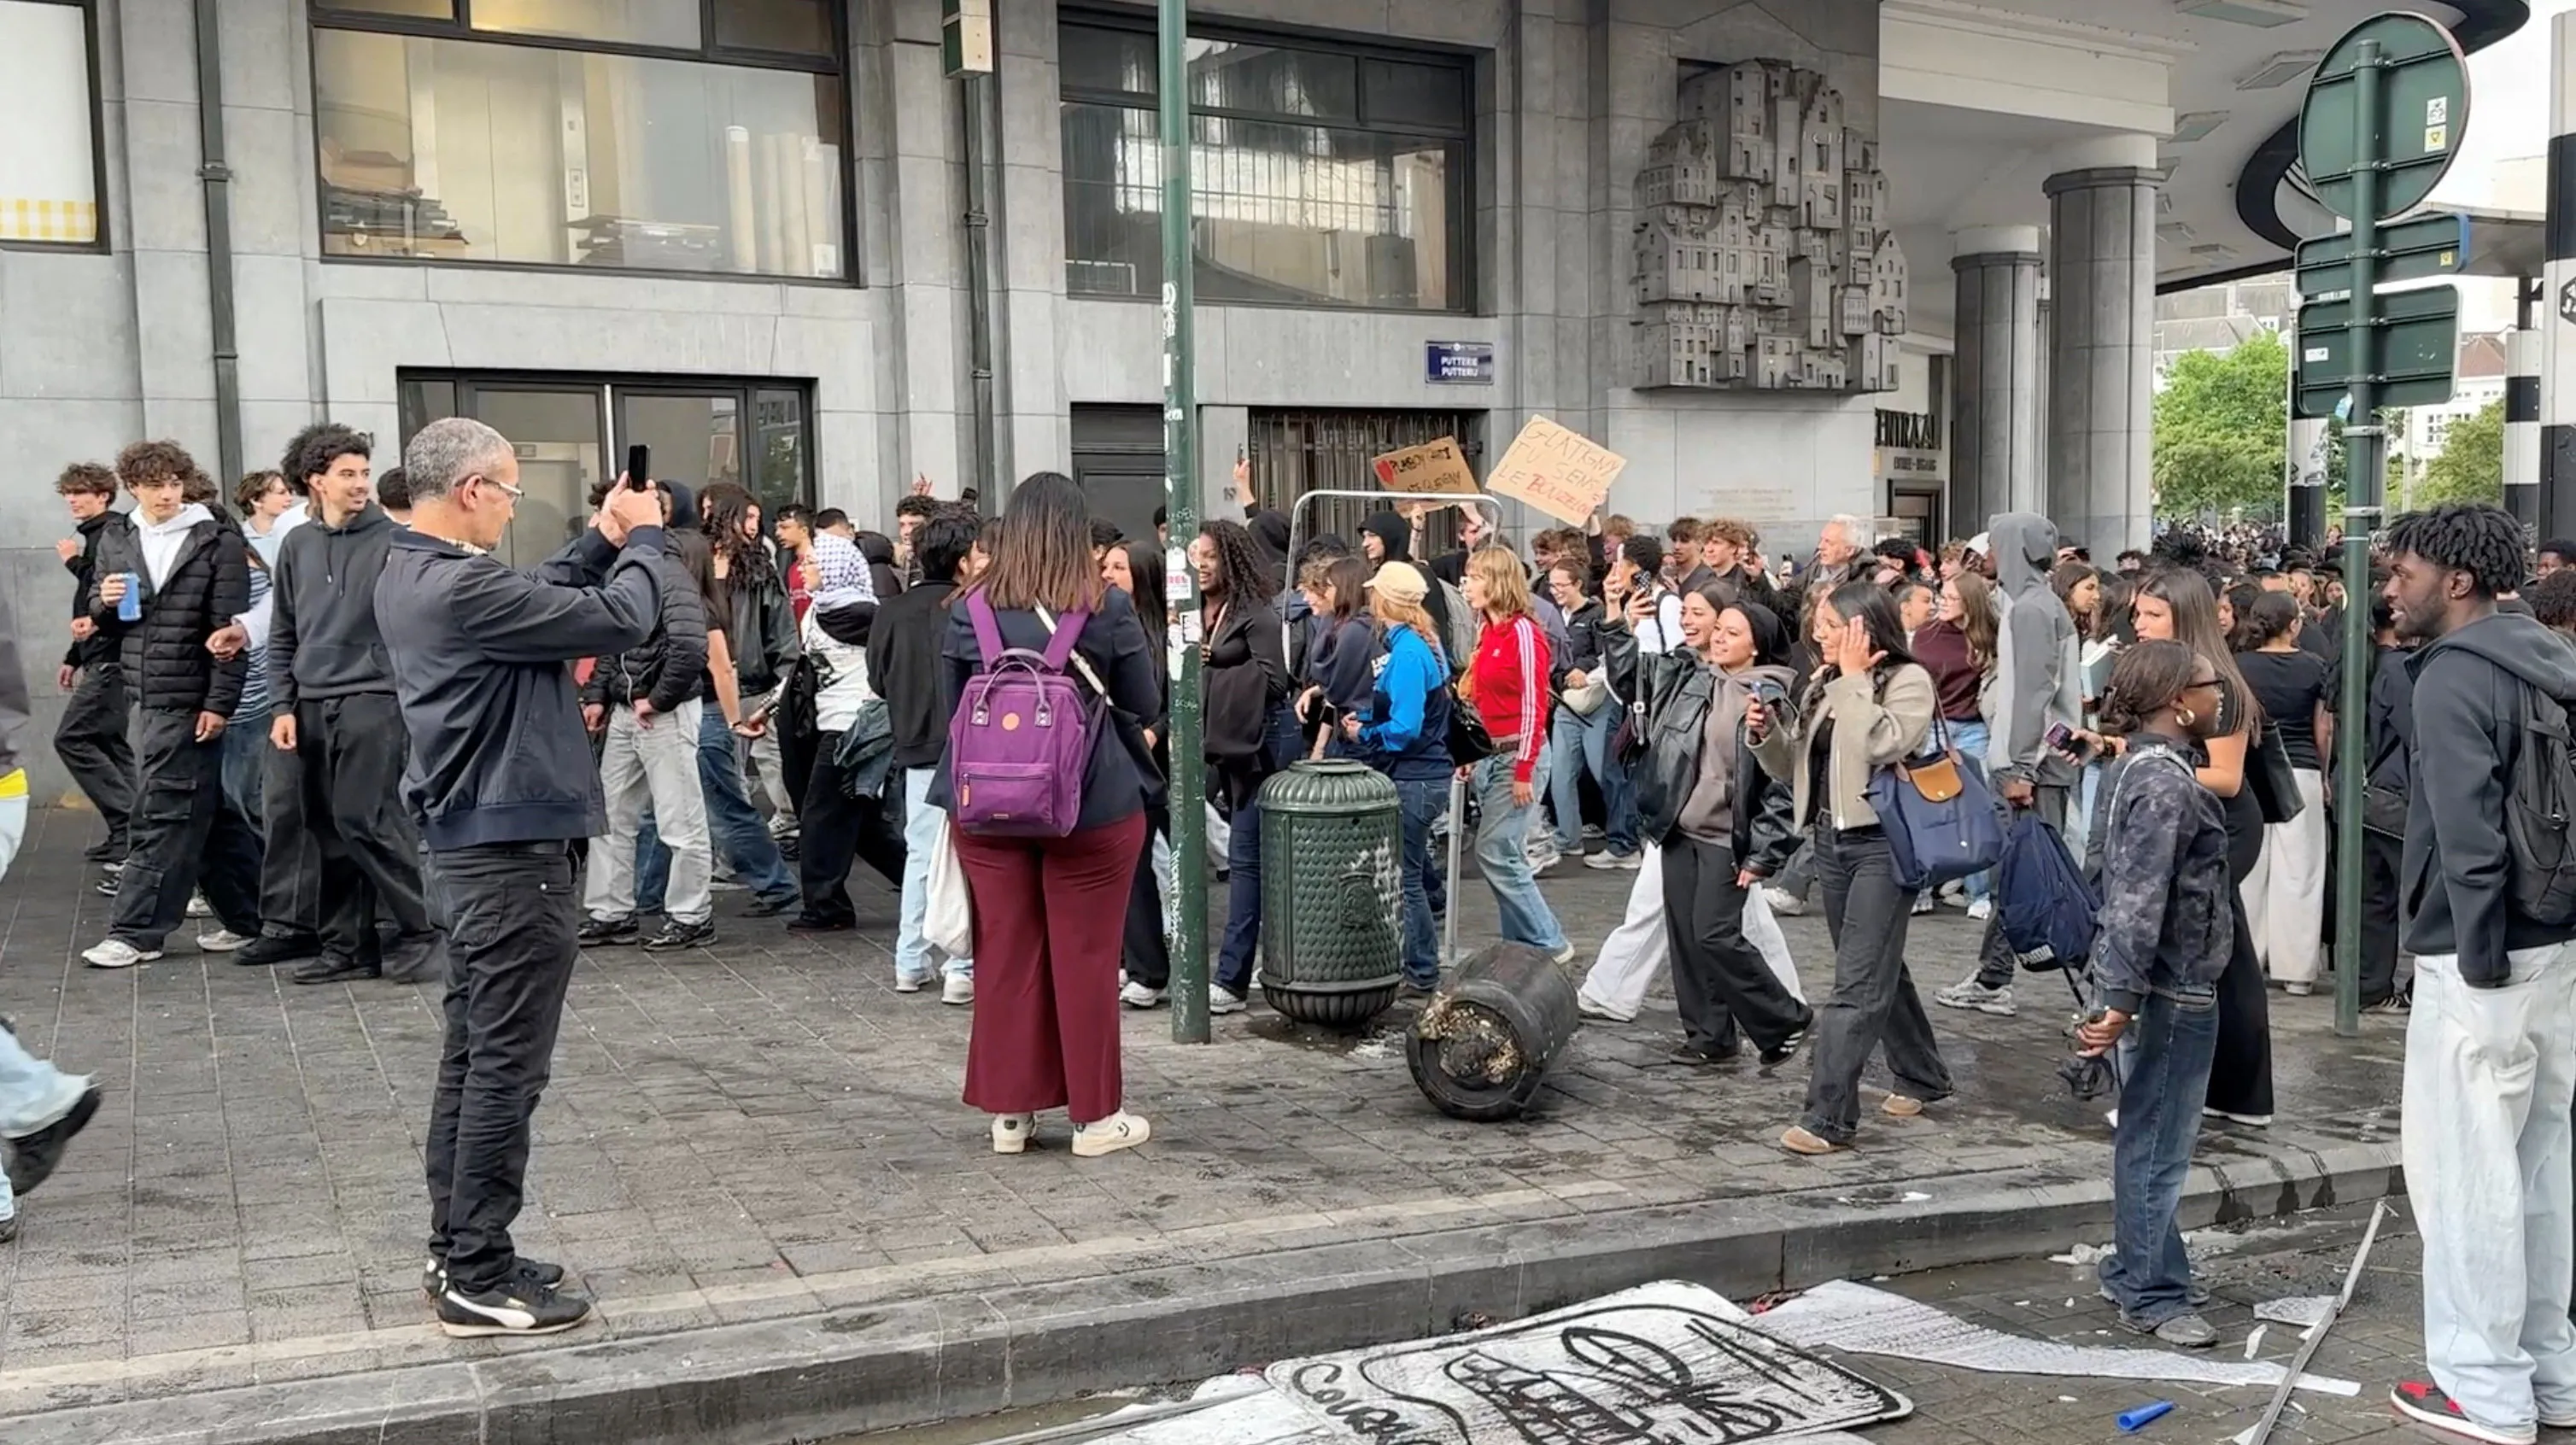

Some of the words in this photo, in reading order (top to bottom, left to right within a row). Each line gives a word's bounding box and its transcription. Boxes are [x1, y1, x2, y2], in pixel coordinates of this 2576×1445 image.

[1511, 440, 1541, 464] TU
[1497, 463, 1526, 486] LE
[1552, 461, 1601, 492] SENS
